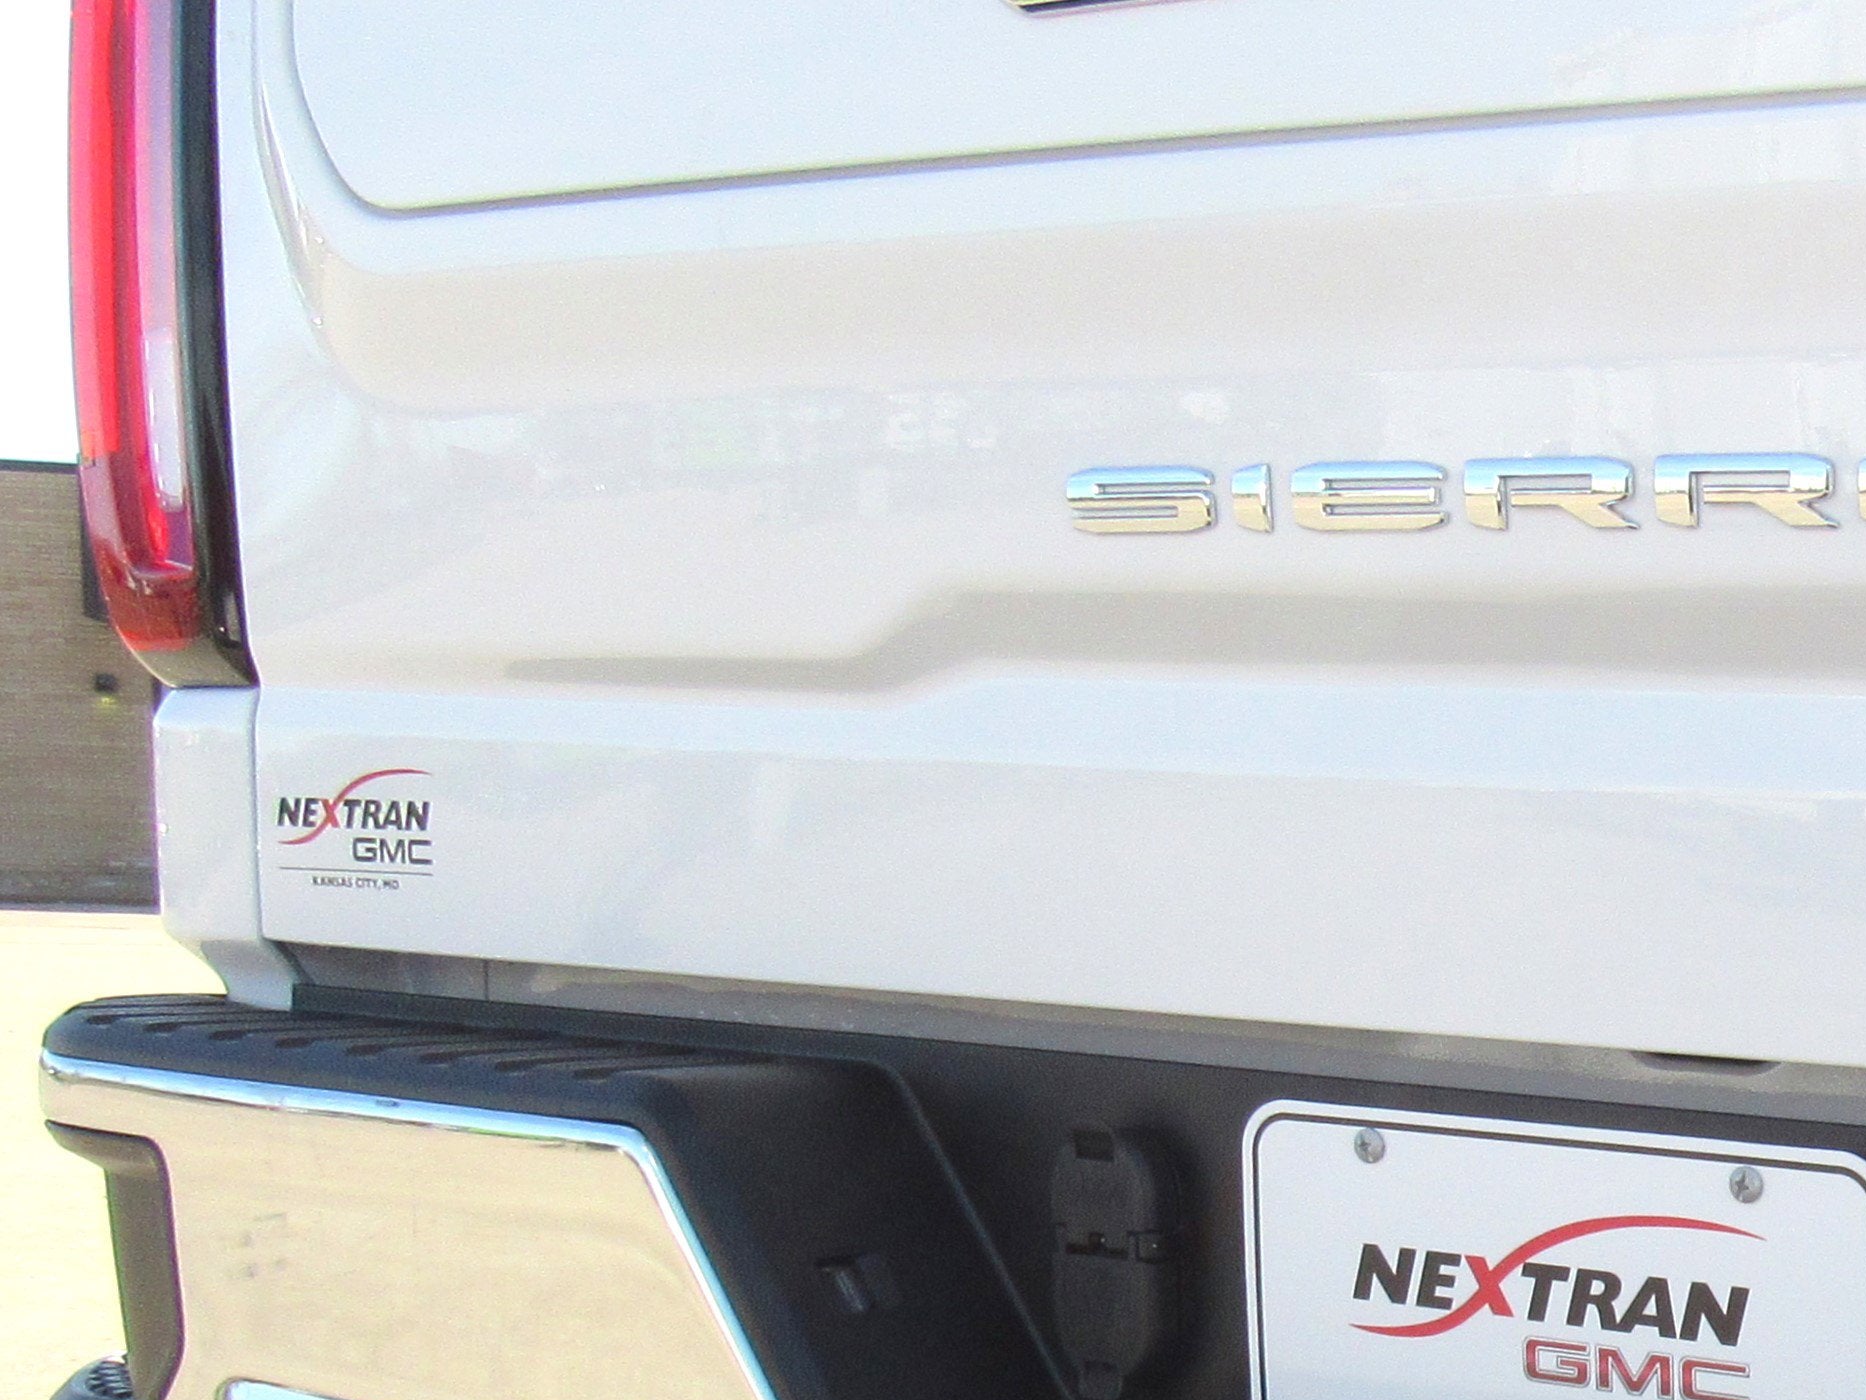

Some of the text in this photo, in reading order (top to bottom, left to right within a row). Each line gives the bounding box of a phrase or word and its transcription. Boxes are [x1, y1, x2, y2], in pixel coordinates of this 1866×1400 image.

[277, 797, 430, 831] NEXTRAN
[352, 837, 433, 865] GMC
[312, 875, 352, 888] KANSAS
[1352, 1243, 1750, 1347] NEXTRAN
